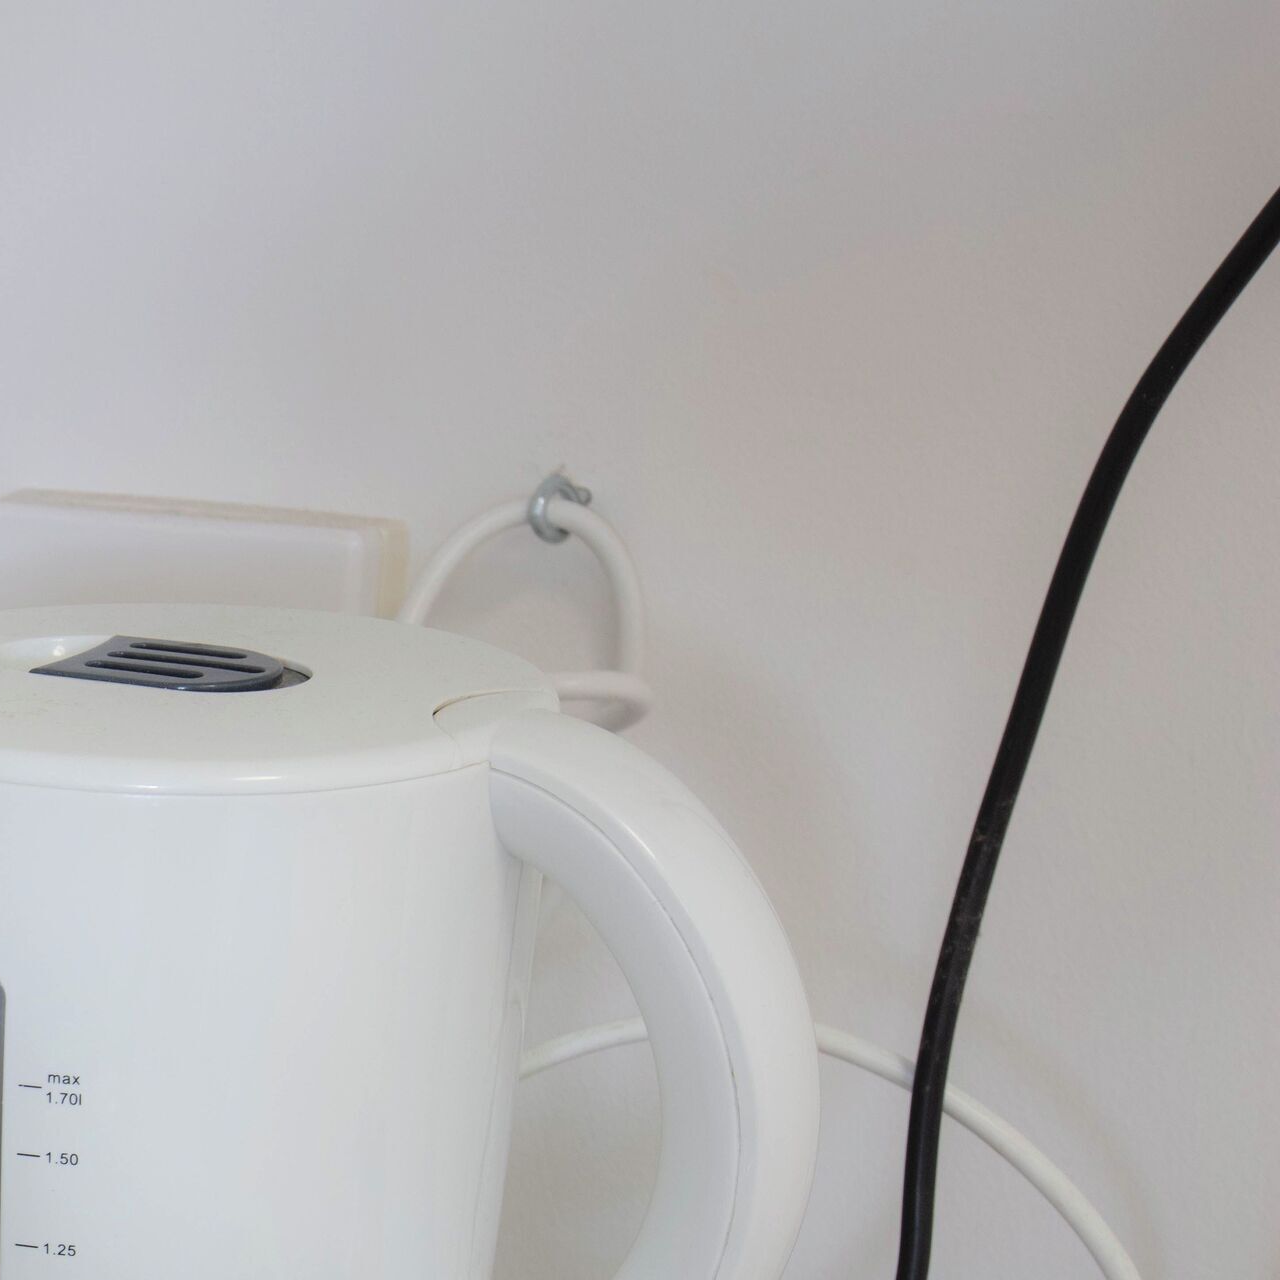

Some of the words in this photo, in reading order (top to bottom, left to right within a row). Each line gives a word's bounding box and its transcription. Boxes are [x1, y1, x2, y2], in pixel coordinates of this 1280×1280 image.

[47, 1072, 81, 1085] max
[44, 1151, 79, 1166] 1.50
[42, 1242, 77, 1257] 1.25
